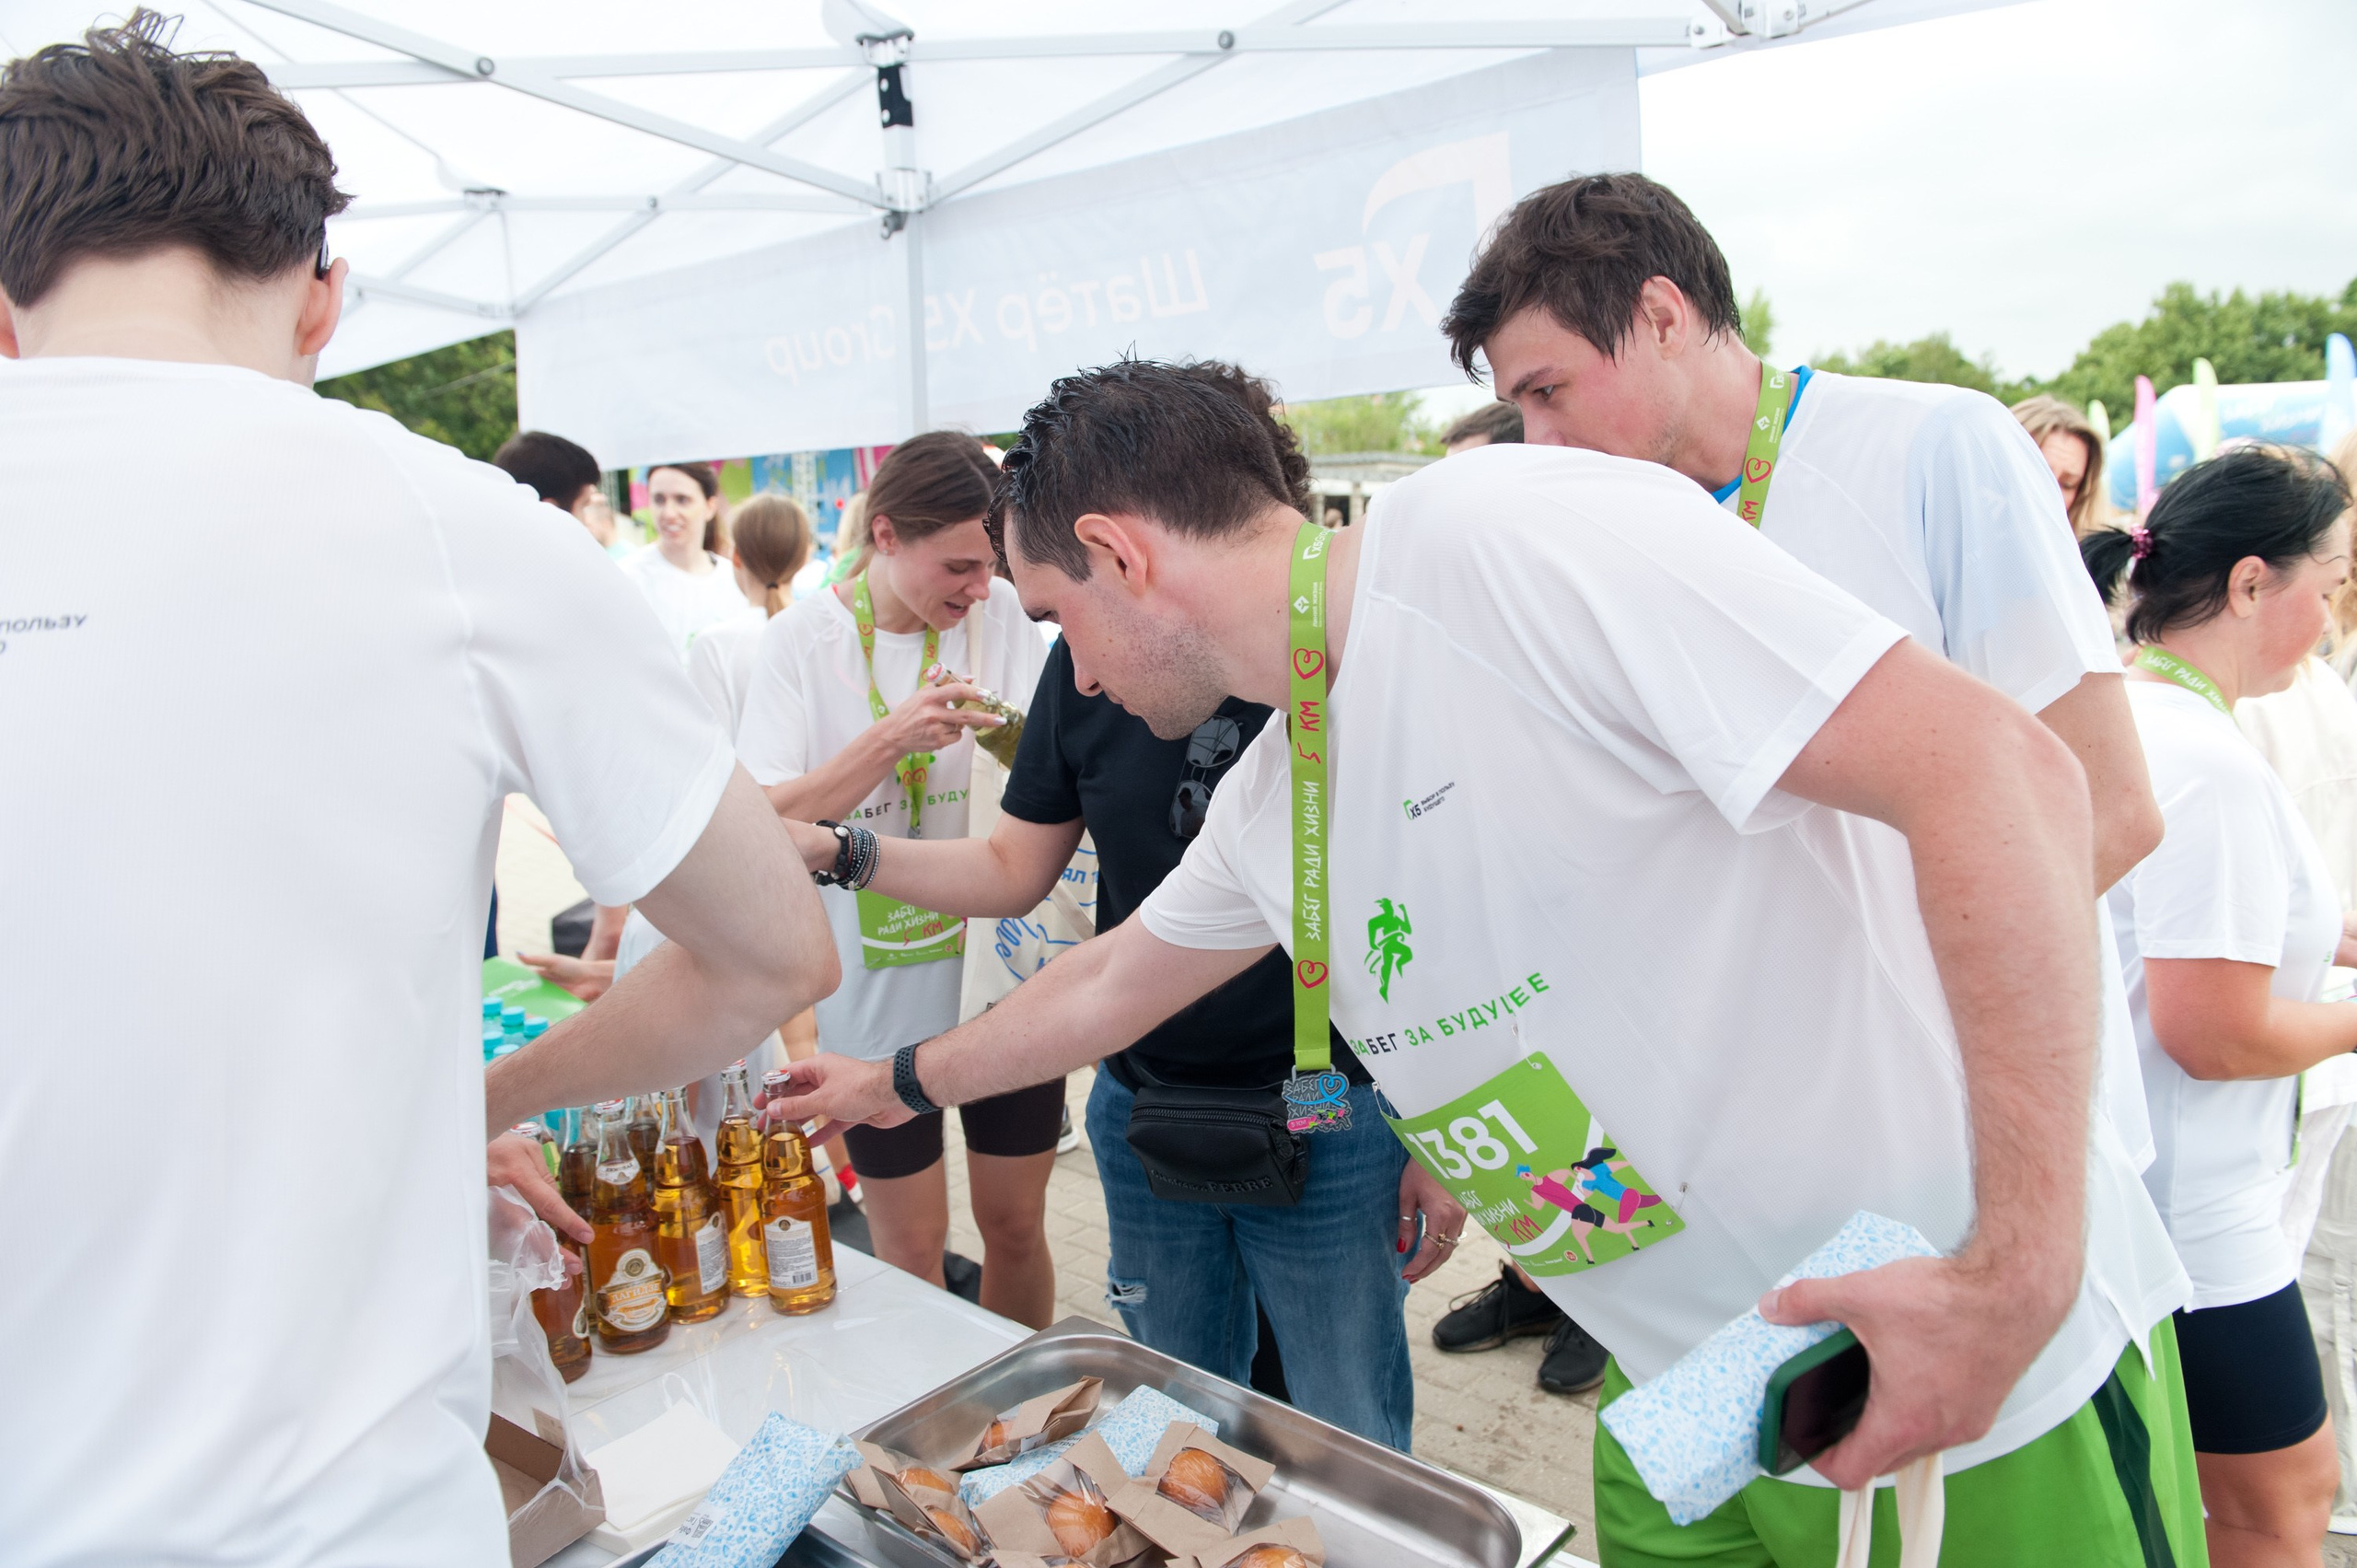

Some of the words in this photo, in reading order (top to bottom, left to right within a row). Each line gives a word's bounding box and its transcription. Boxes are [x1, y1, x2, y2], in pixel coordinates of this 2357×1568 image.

[1298, 701, 1320, 732] КМ
[1297, 741, 1321, 764] 5
[1303, 781, 1320, 837] ЖИЗНИ
[1410, 803, 1422, 819] X5
[1304, 843, 1321, 889] РАДИ
[1303, 893, 1320, 942] ЗАБЕГ
[1350, 1032, 1397, 1056] ЗАБЕГ
[1404, 1026, 1434, 1047] ЗА
[1404, 1099, 1539, 1179] 1381
[1508, 1214, 1544, 1244] КМ
